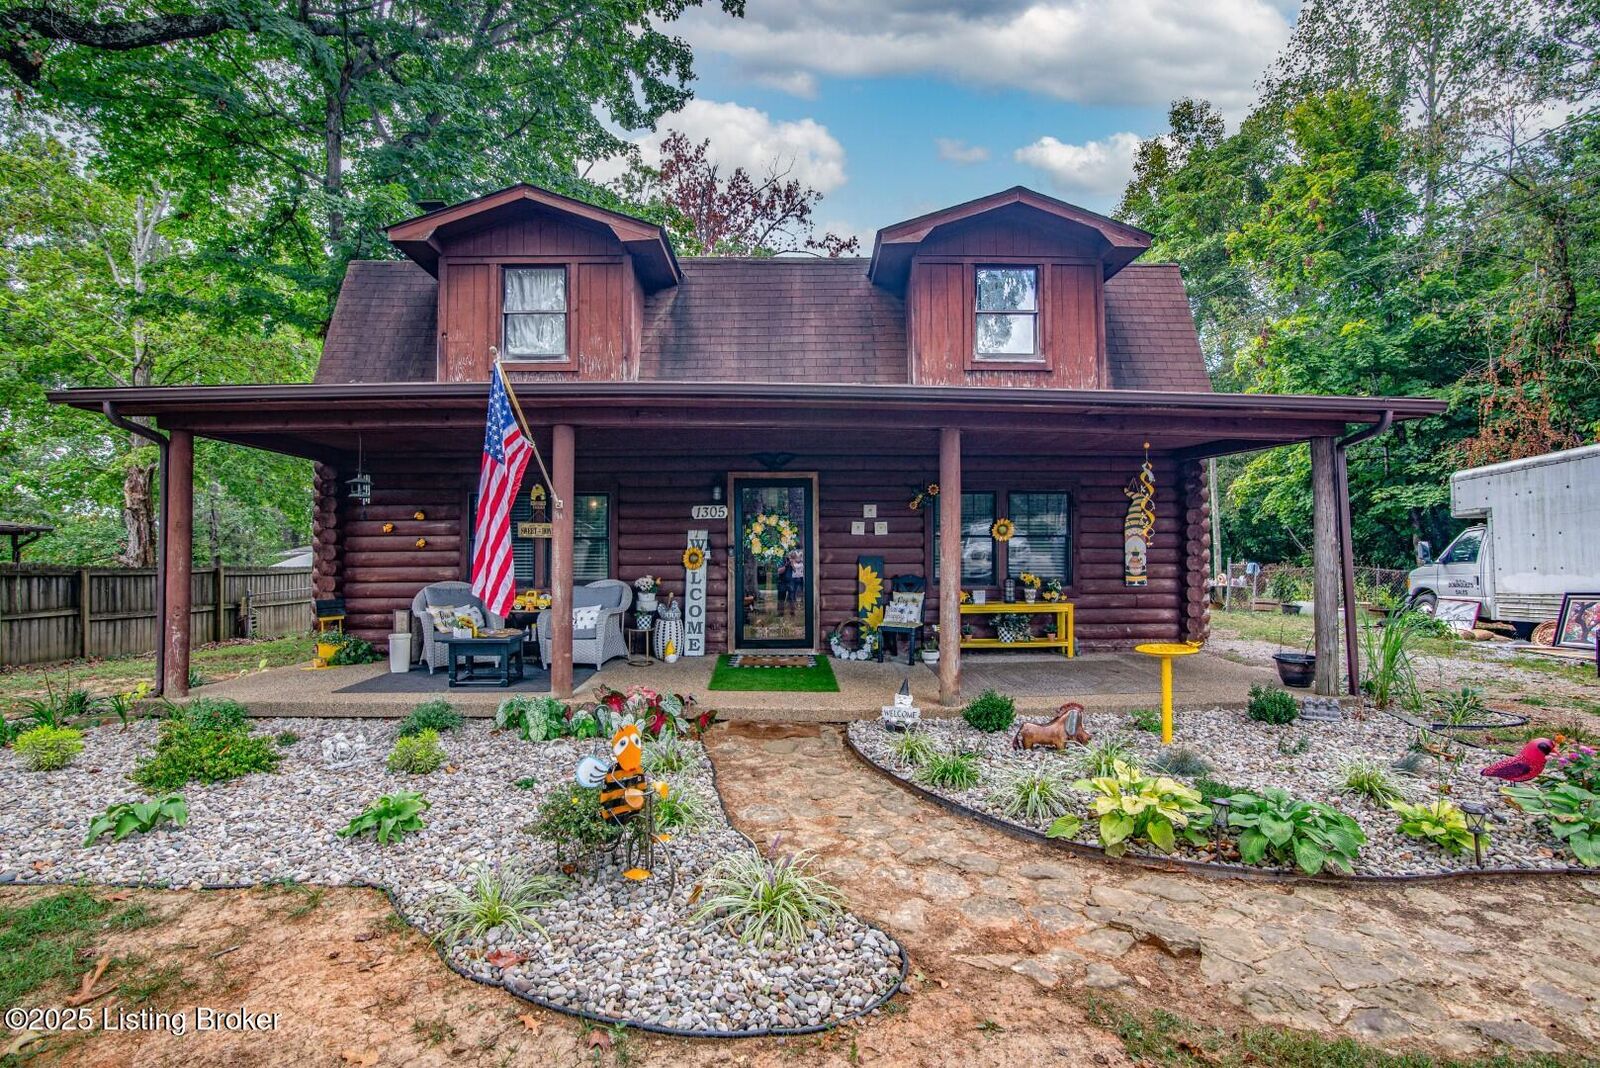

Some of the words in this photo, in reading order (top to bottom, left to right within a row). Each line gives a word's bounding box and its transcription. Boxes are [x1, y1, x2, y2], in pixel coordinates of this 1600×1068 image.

[695, 505, 727, 518] 1305
[686, 539, 707, 652] WLCOME
[883, 709, 918, 719] WELCOME
